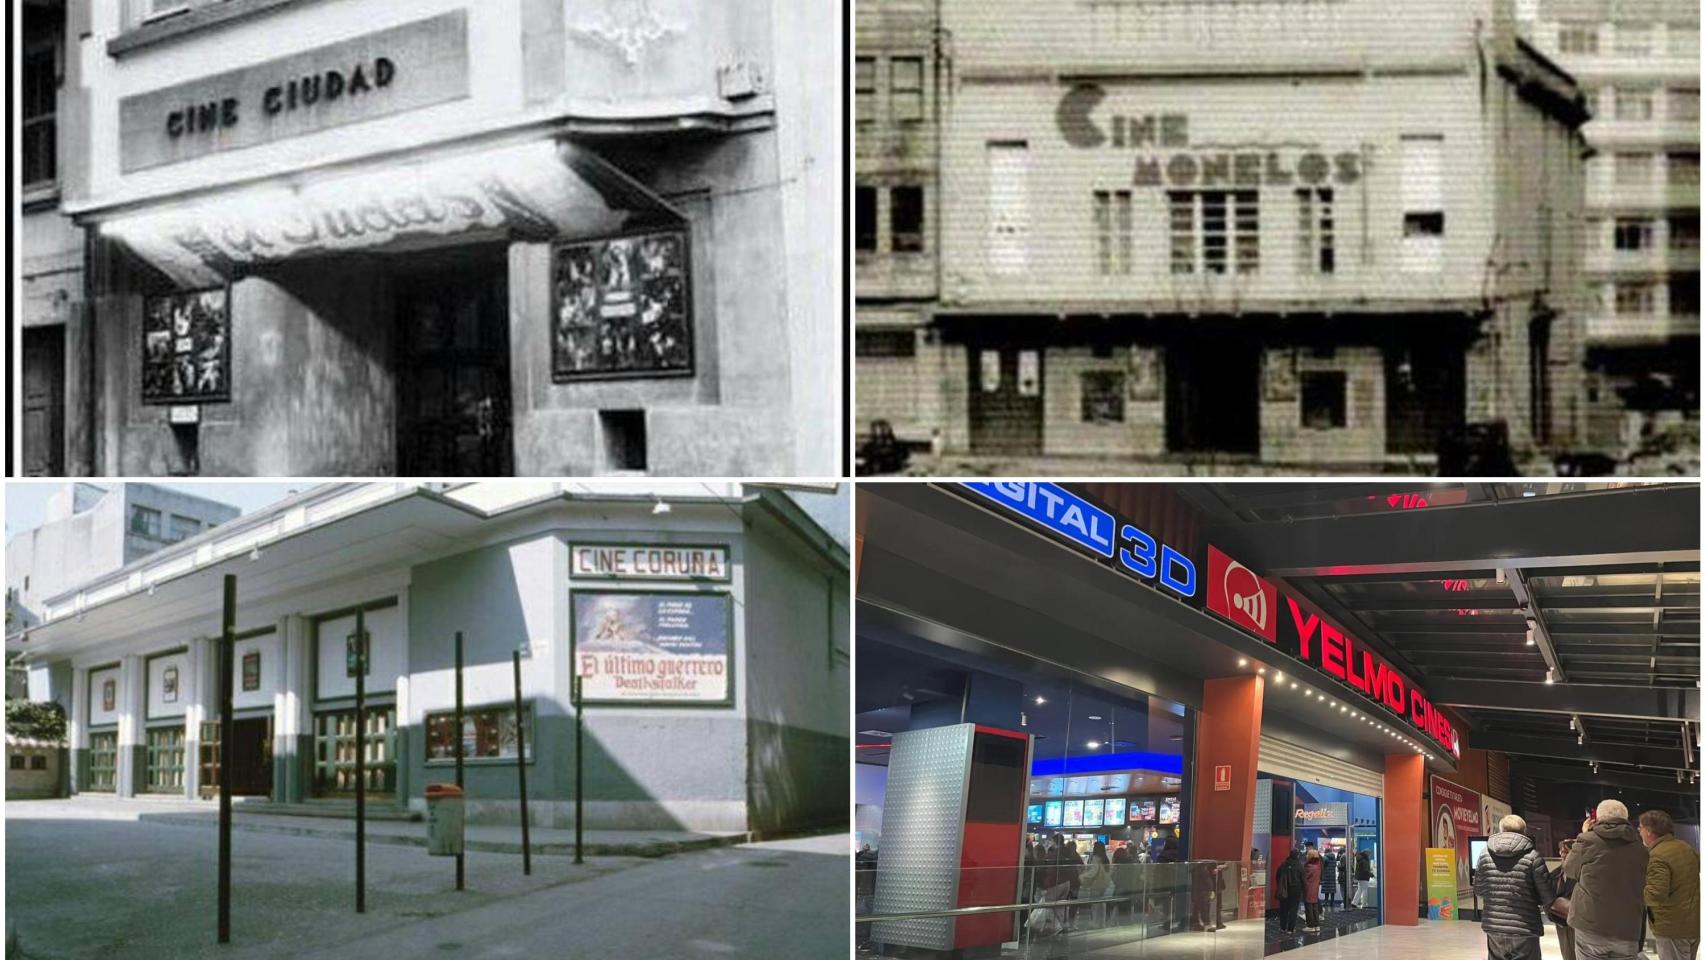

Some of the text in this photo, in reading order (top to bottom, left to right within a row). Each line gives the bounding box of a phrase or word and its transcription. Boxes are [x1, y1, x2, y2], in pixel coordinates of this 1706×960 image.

[166, 57, 396, 138] CINE CIUDAD
[1056, 82, 1188, 148] CINE
[1133, 152, 1361, 185] MONELOS
[579, 548, 720, 575] CINE CORUÑA
[981, 482, 1197, 598] GITAL 3D
[581, 655, 723, 678] El último guerrero
[1286, 594, 1452, 750] YELMO CINES
